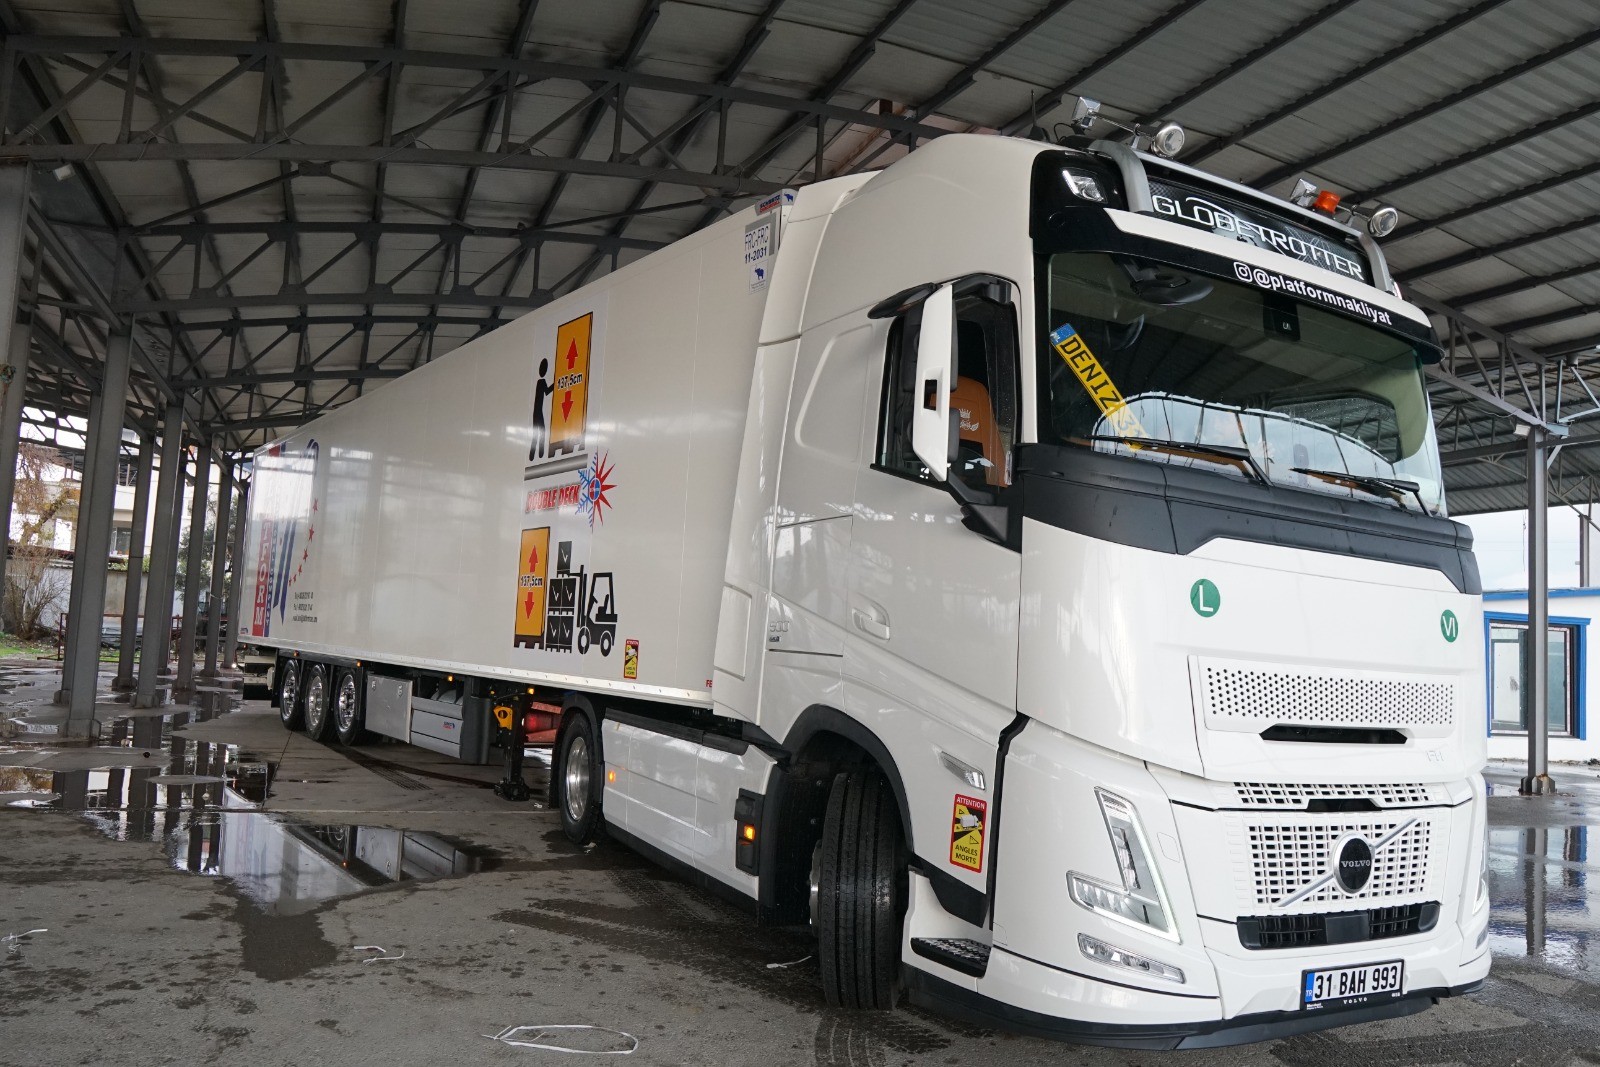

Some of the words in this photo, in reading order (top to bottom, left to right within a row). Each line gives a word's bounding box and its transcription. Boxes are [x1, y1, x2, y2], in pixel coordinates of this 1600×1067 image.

[1151, 195, 1365, 281] GLOBETROTTER
[744, 246, 768, 264] 11-2031
[1254, 269, 1392, 326] @platformnakliyat
[1060, 337, 1120, 410] DENIZ
[525, 489, 557, 514] DOUBLE
[558, 485, 581, 507] DECK
[1199, 584, 1214, 613] L
[956, 796, 985, 810] ATTENTION
[955, 844, 978, 857] ANGLES
[955, 852, 977, 865] MORTS
[1341, 859, 1371, 868] VOLVO
[1314, 973, 1333, 999] 31
[1339, 969, 1367, 996] BAH
[1371, 965, 1398, 991] 993
[1343, 997, 1368, 1005] VOLVO
